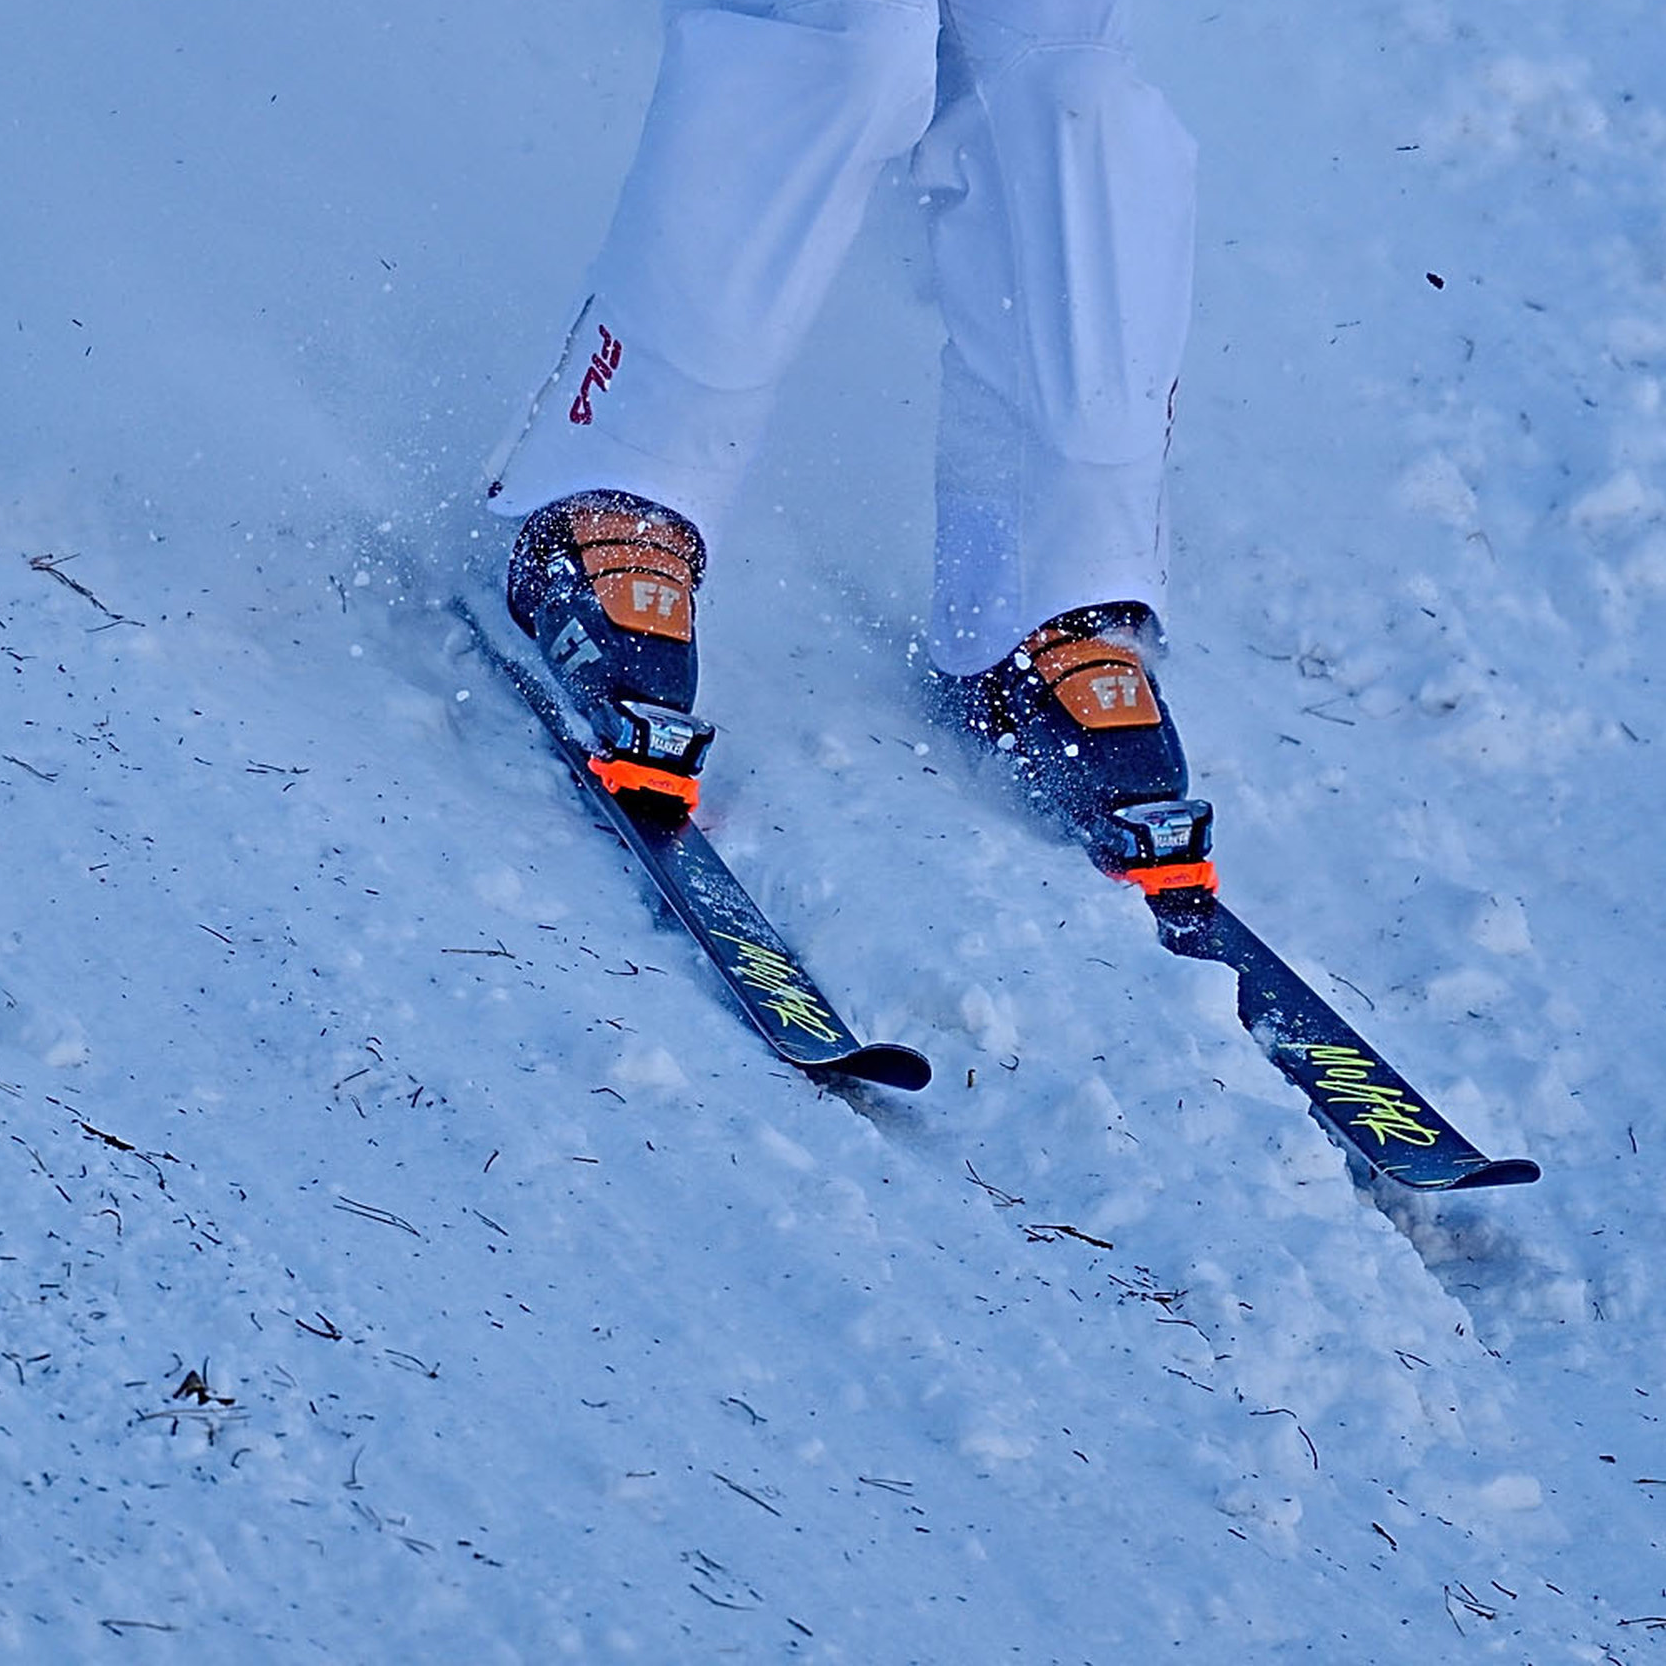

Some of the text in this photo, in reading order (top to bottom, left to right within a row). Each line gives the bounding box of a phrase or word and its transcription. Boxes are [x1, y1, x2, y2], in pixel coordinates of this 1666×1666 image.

[570, 324, 623, 426] FILA
[632, 580, 681, 617] FT
[549, 617, 604, 675] FT
[1088, 675, 1140, 710] FT
